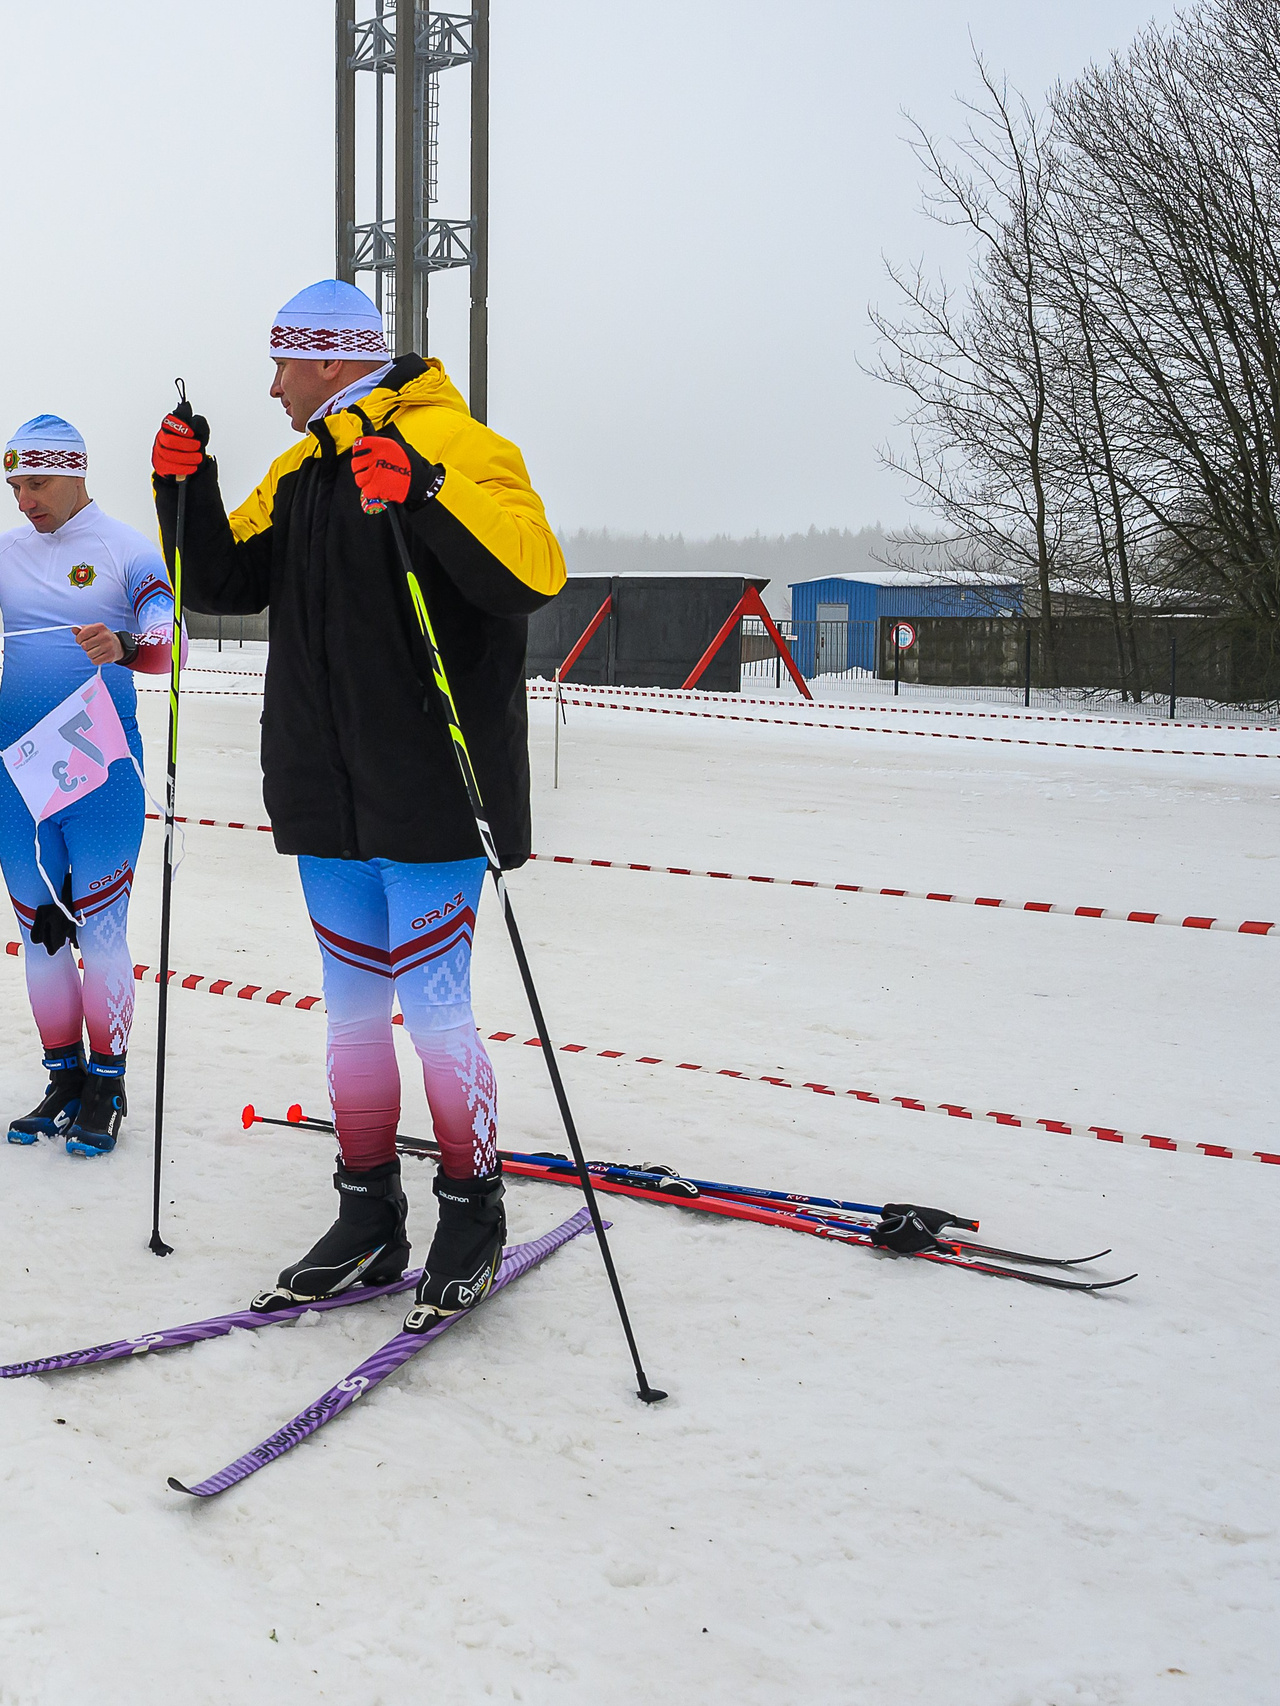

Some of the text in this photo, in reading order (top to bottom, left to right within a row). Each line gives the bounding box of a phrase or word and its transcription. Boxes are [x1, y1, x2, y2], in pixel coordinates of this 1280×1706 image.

[163, 418, 189, 434] oeckl
[89, 859, 129, 890] ORAZ
[411, 891, 465, 930] ORAZ
